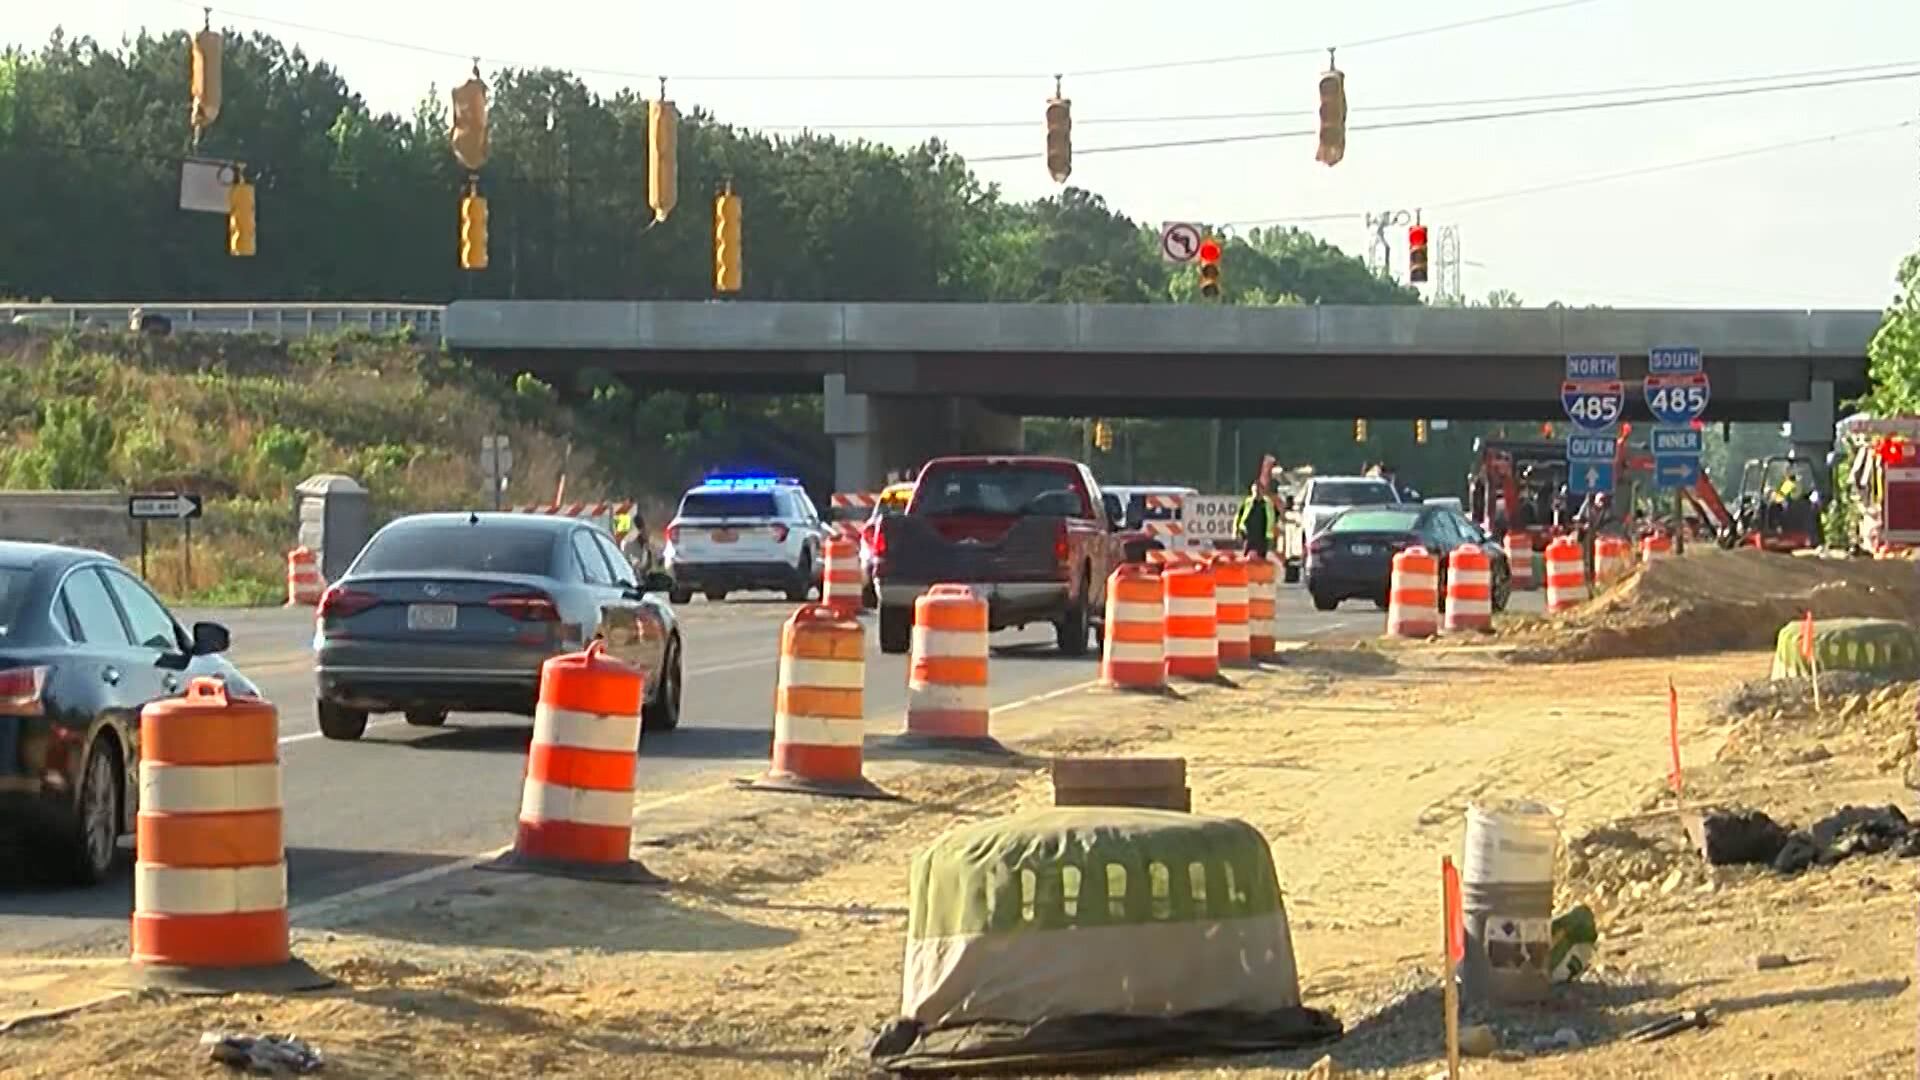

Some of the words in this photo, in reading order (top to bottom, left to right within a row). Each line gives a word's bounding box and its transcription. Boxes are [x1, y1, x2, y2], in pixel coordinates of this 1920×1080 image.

[1569, 359, 1616, 374] NORTH
[1654, 352, 1699, 368] SOUTH
[1652, 388, 1704, 412] 485
[1570, 396, 1618, 421] 485
[1571, 439, 1614, 454] OUTER
[1658, 433, 1697, 448] INNER
[1196, 503, 1238, 516] ROAD
